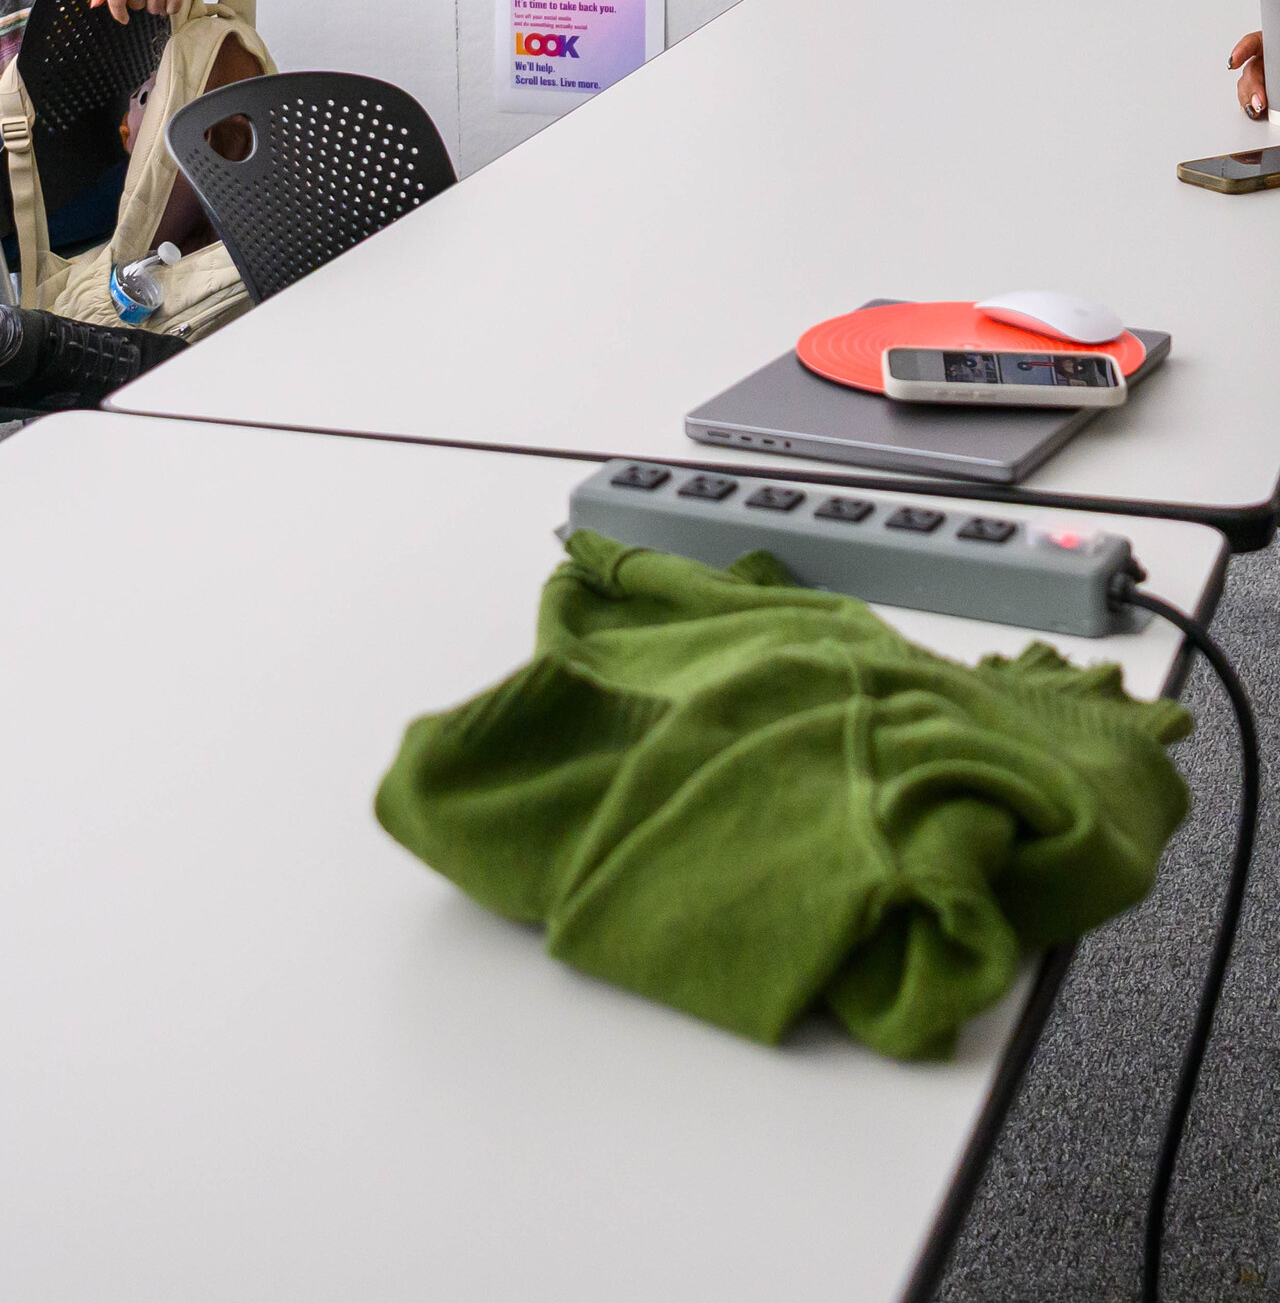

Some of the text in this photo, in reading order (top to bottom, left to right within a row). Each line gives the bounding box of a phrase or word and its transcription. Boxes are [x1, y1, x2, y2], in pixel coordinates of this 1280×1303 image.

[515, 0, 616, 14] It's time to take back you.
[516, 33, 580, 58] LOOK
[515, 61, 555, 74] We'll help.
[516, 75, 601, 89] Scroll less. Live more.
